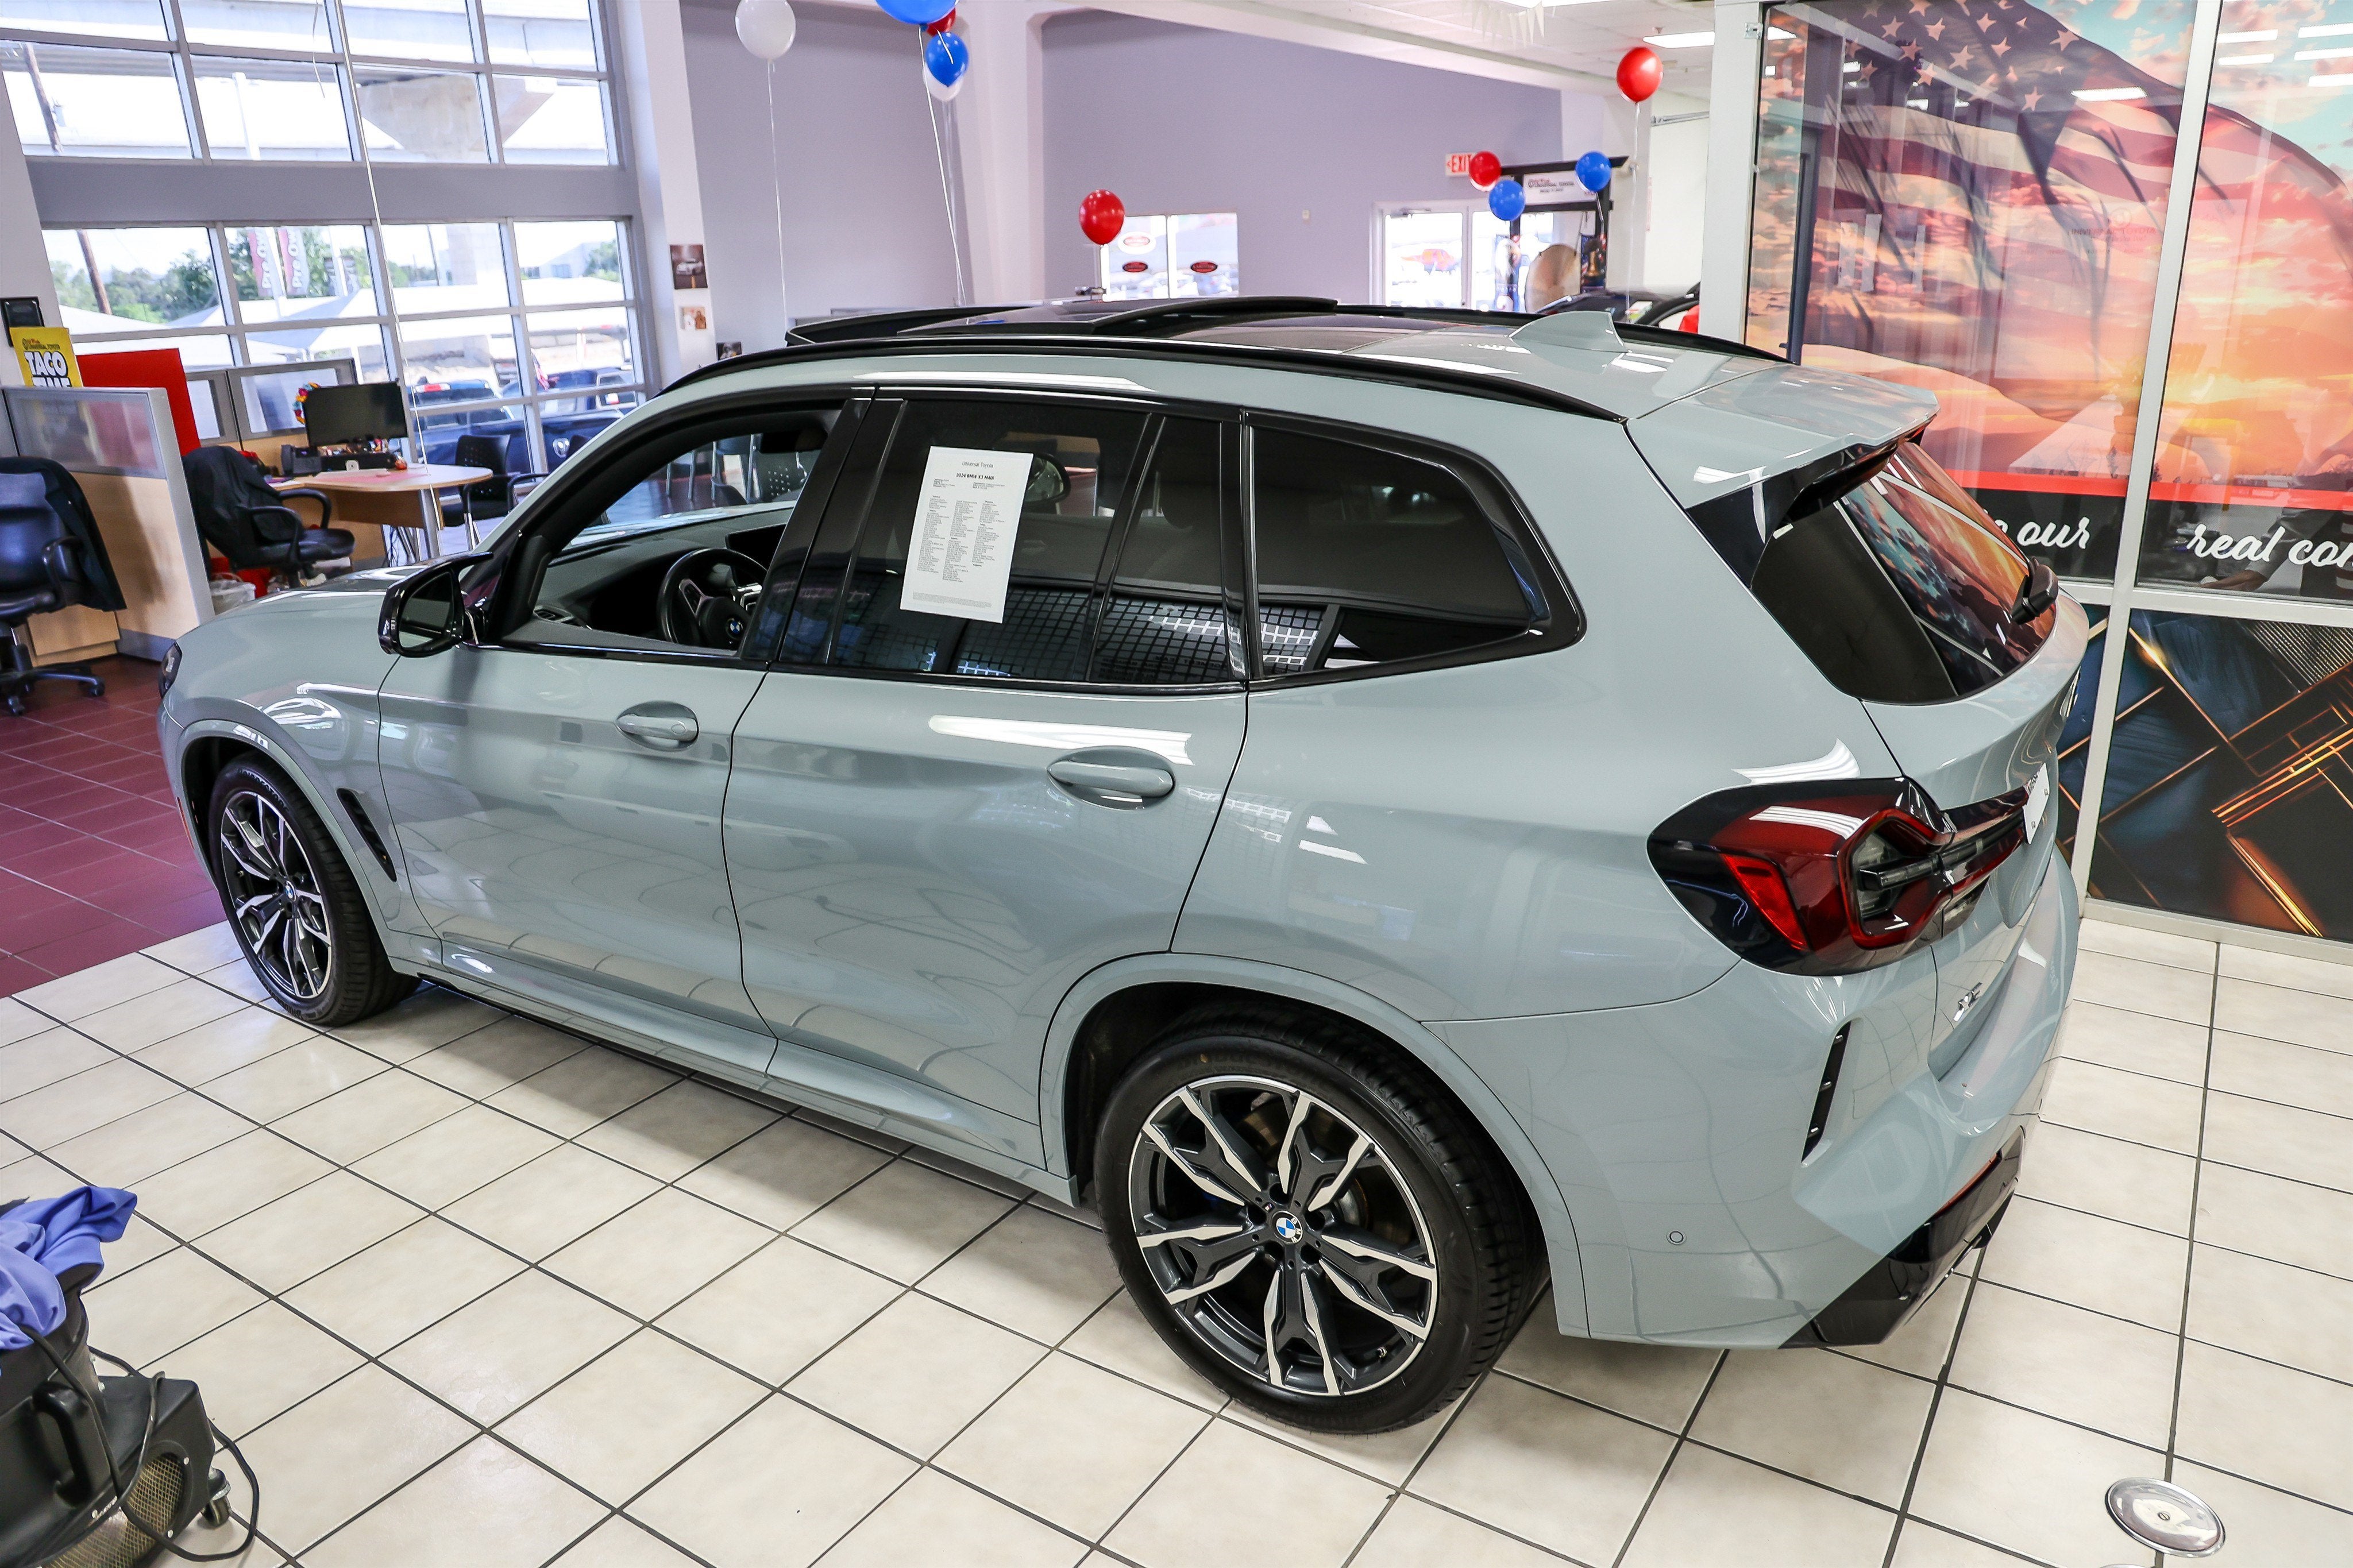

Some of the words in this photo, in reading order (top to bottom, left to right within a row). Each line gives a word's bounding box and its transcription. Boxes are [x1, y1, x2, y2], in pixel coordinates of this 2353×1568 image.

[291, 260, 303, 288] Pre
[24, 350, 68, 378] TACO
[2017, 516, 2090, 550] our
[2186, 523, 2286, 562] real
